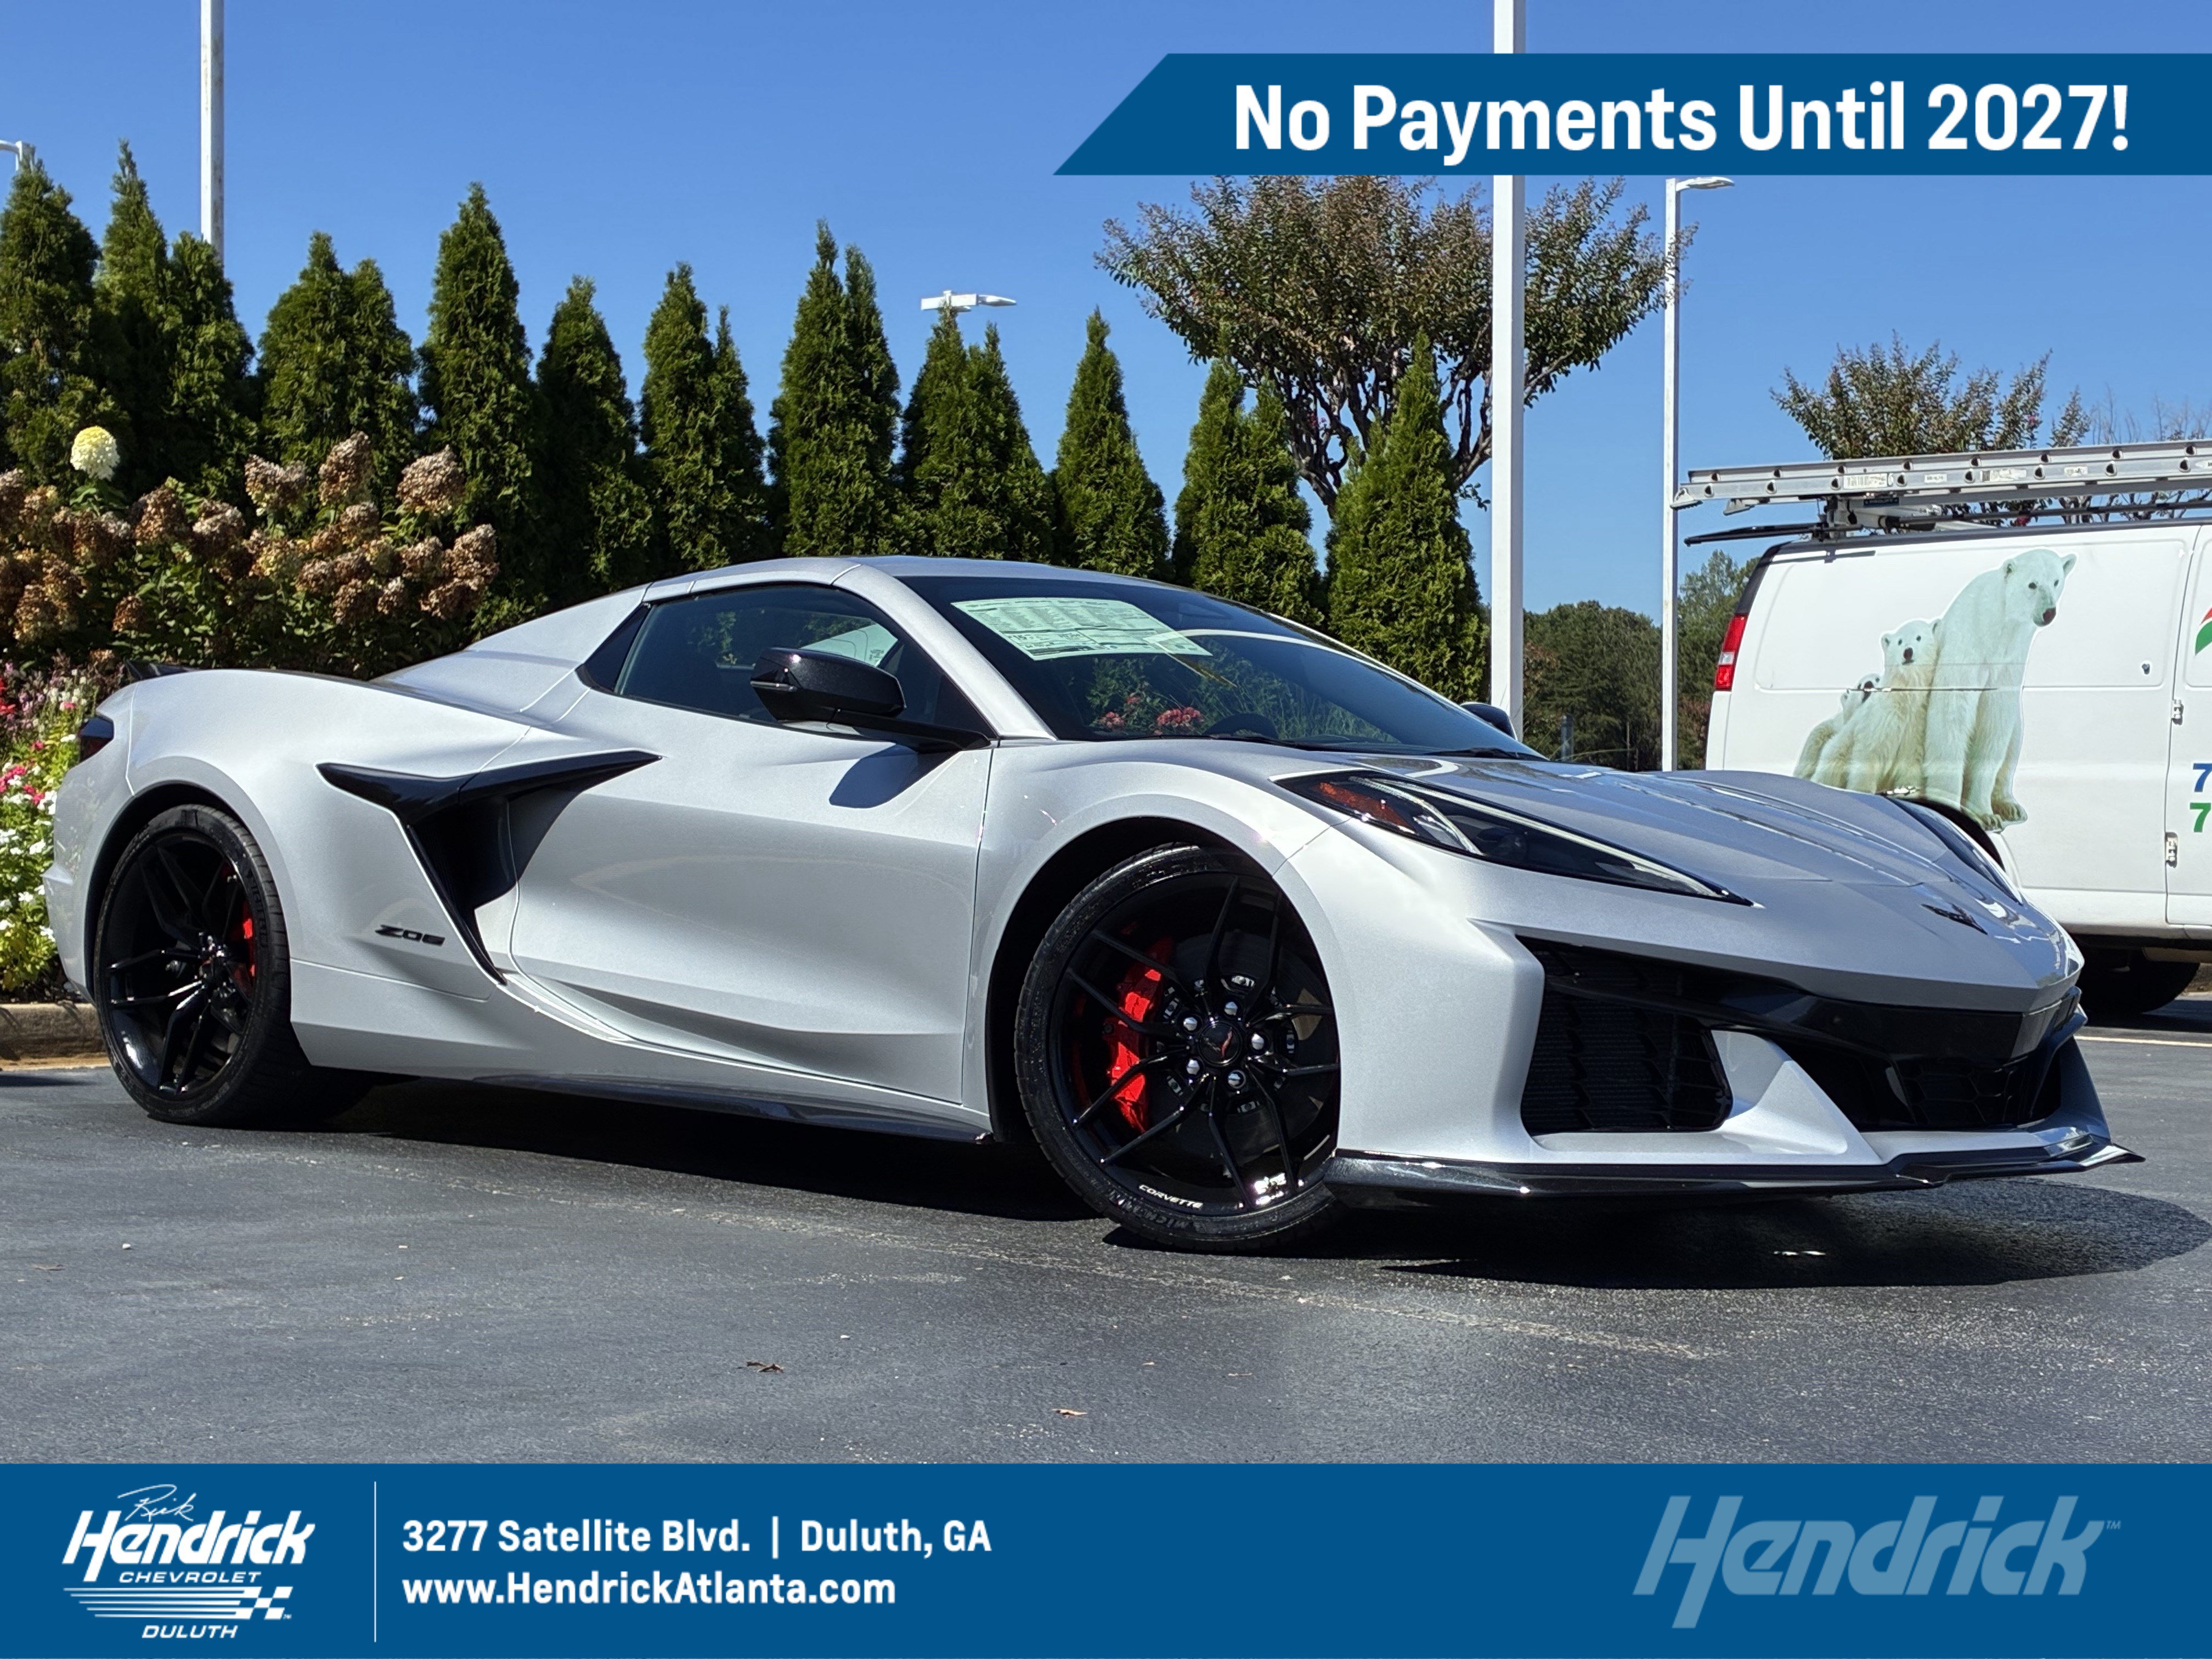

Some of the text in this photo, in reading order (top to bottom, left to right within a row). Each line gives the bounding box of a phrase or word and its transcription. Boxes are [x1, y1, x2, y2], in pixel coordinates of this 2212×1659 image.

[2193, 763, 2212, 792] 7
[2190, 803, 2211, 832] 7
[375, 924, 445, 946] Z06
[1139, 1184, 1204, 1209] CORVETTE
